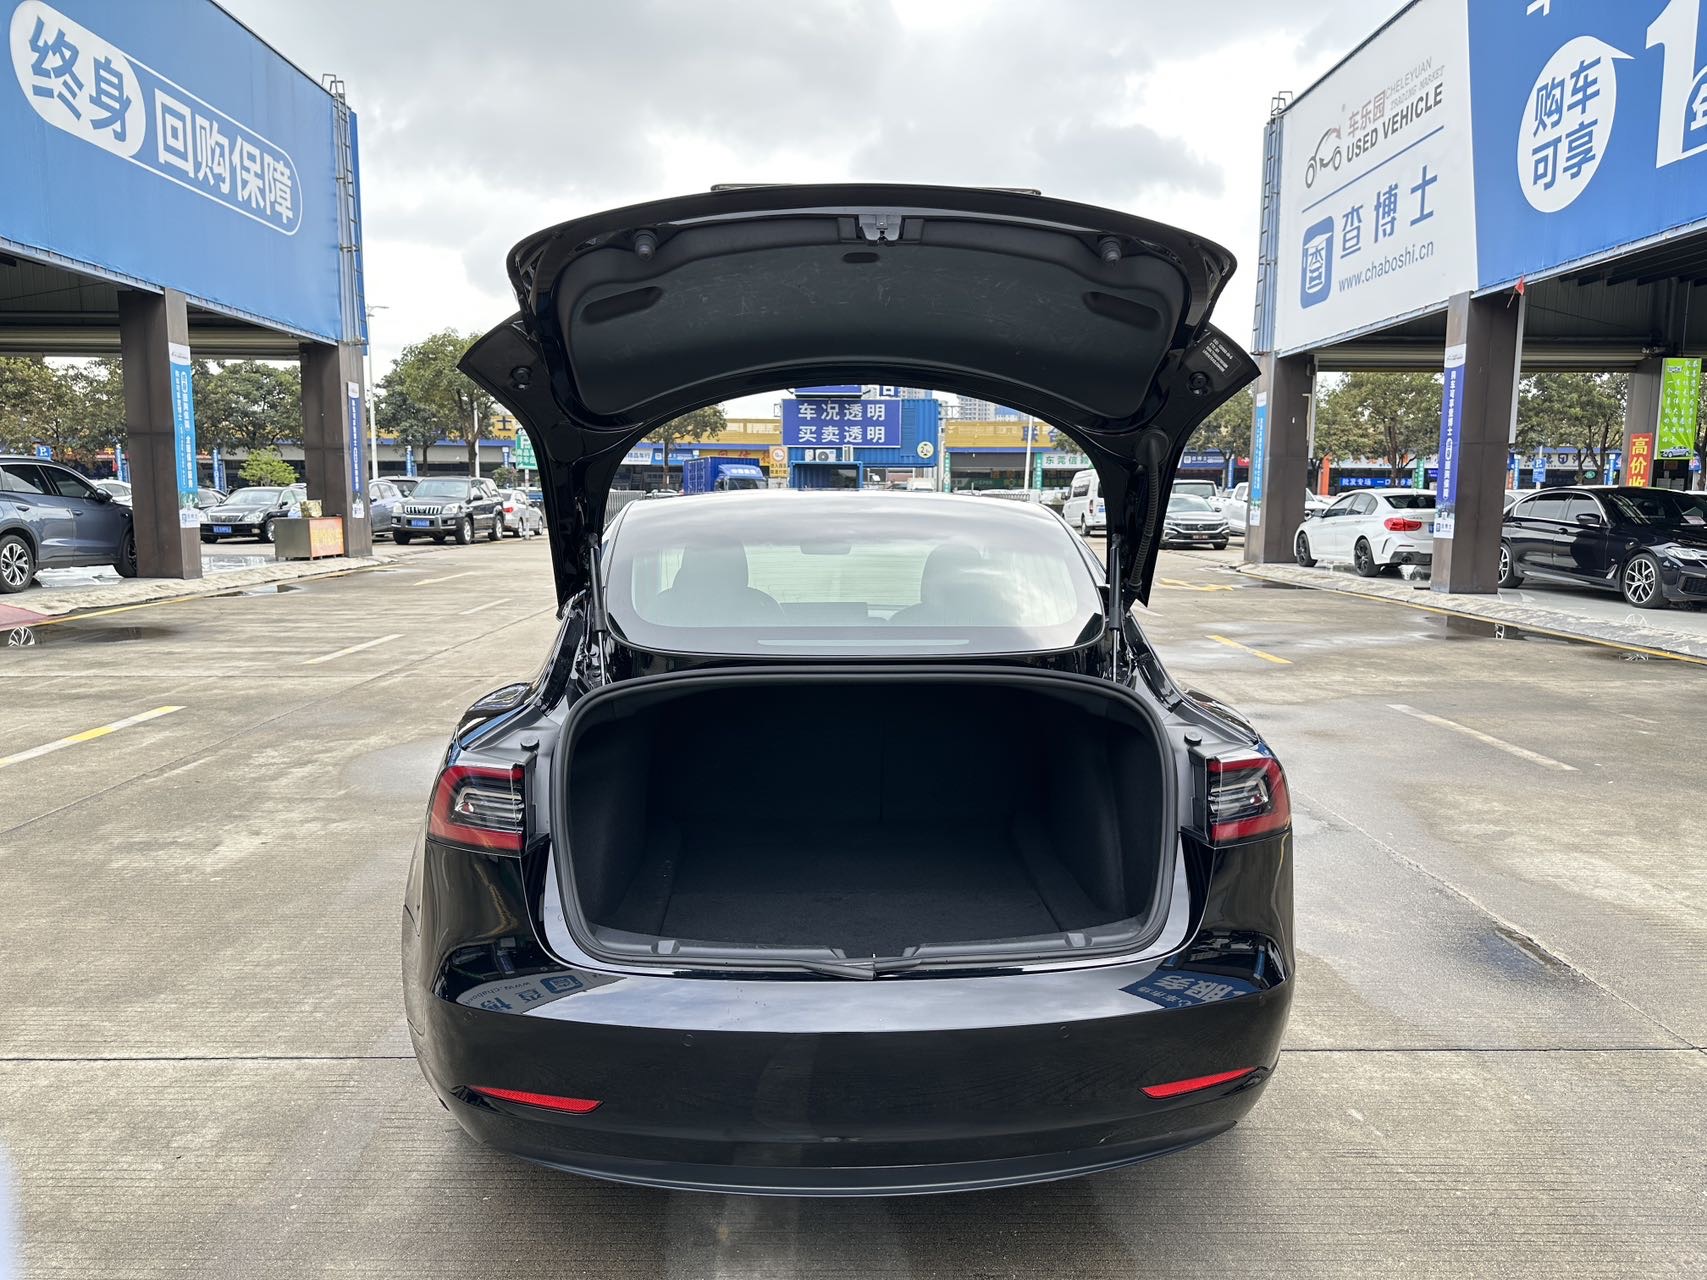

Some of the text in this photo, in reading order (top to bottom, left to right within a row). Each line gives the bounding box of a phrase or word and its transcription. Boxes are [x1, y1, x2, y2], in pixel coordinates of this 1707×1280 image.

[1386, 56, 1432, 99] CHELEYUAN
[1533, 56, 1602, 138] 购车
[29, 15, 294, 223] 终身 回购保障
[1346, 82, 1443, 163] USED VEHICLE
[1348, 89, 1386, 138] 车乐园
[1532, 118, 1599, 191] 可享
[1340, 165, 1438, 259] 查博士
[1338, 241, 1435, 293] www.chaboshi.cn
[798, 403, 886, 421] 车况透明
[798, 425, 886, 443] 买卖透明
[1629, 437, 1649, 487] 高价收
